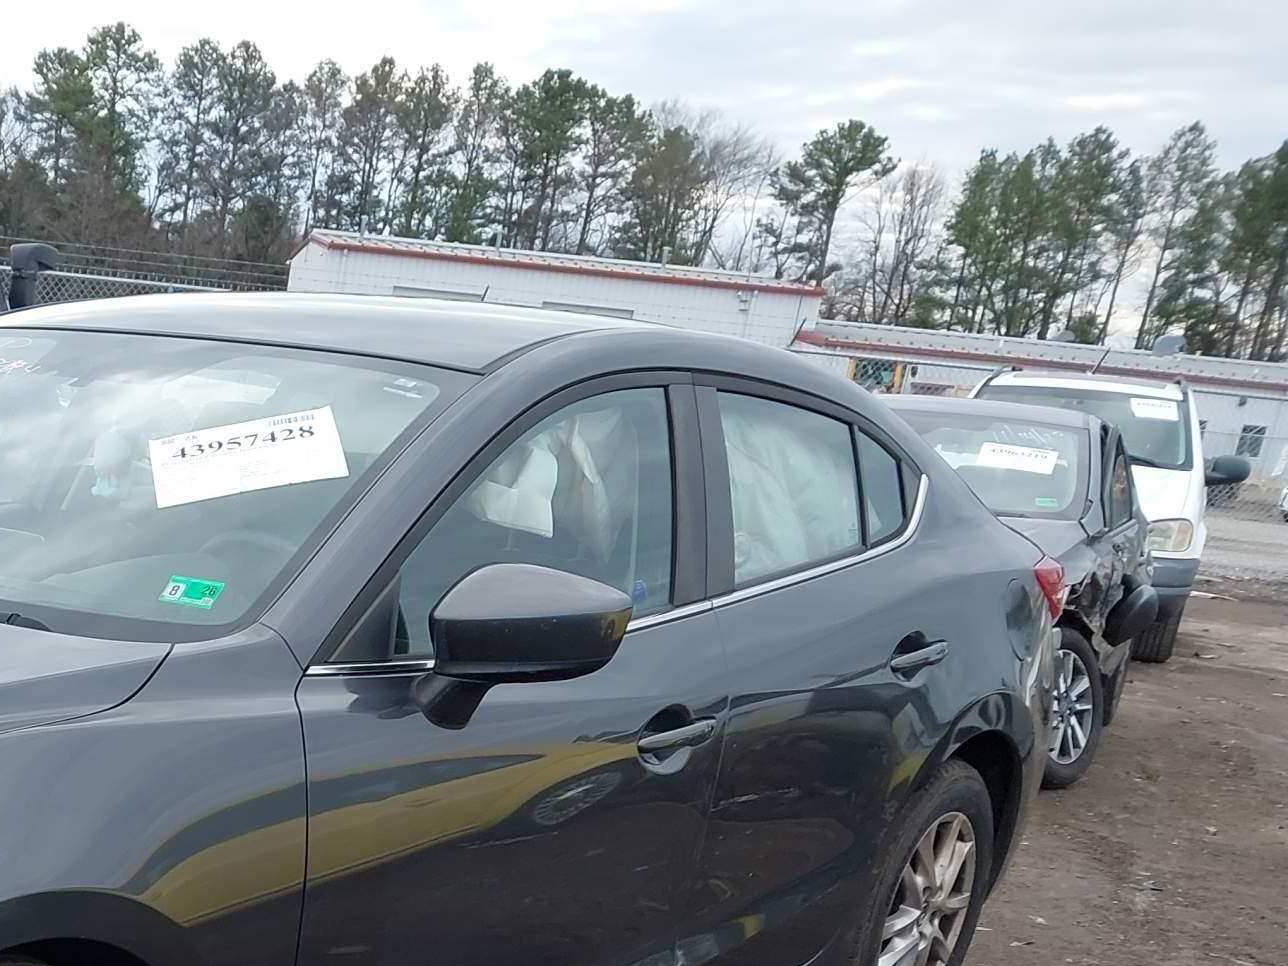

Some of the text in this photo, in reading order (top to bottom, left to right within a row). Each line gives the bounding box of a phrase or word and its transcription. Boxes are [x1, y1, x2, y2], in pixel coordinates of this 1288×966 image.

[172, 424, 316, 460] 43957428
[169, 584, 217, 597] 8 26
